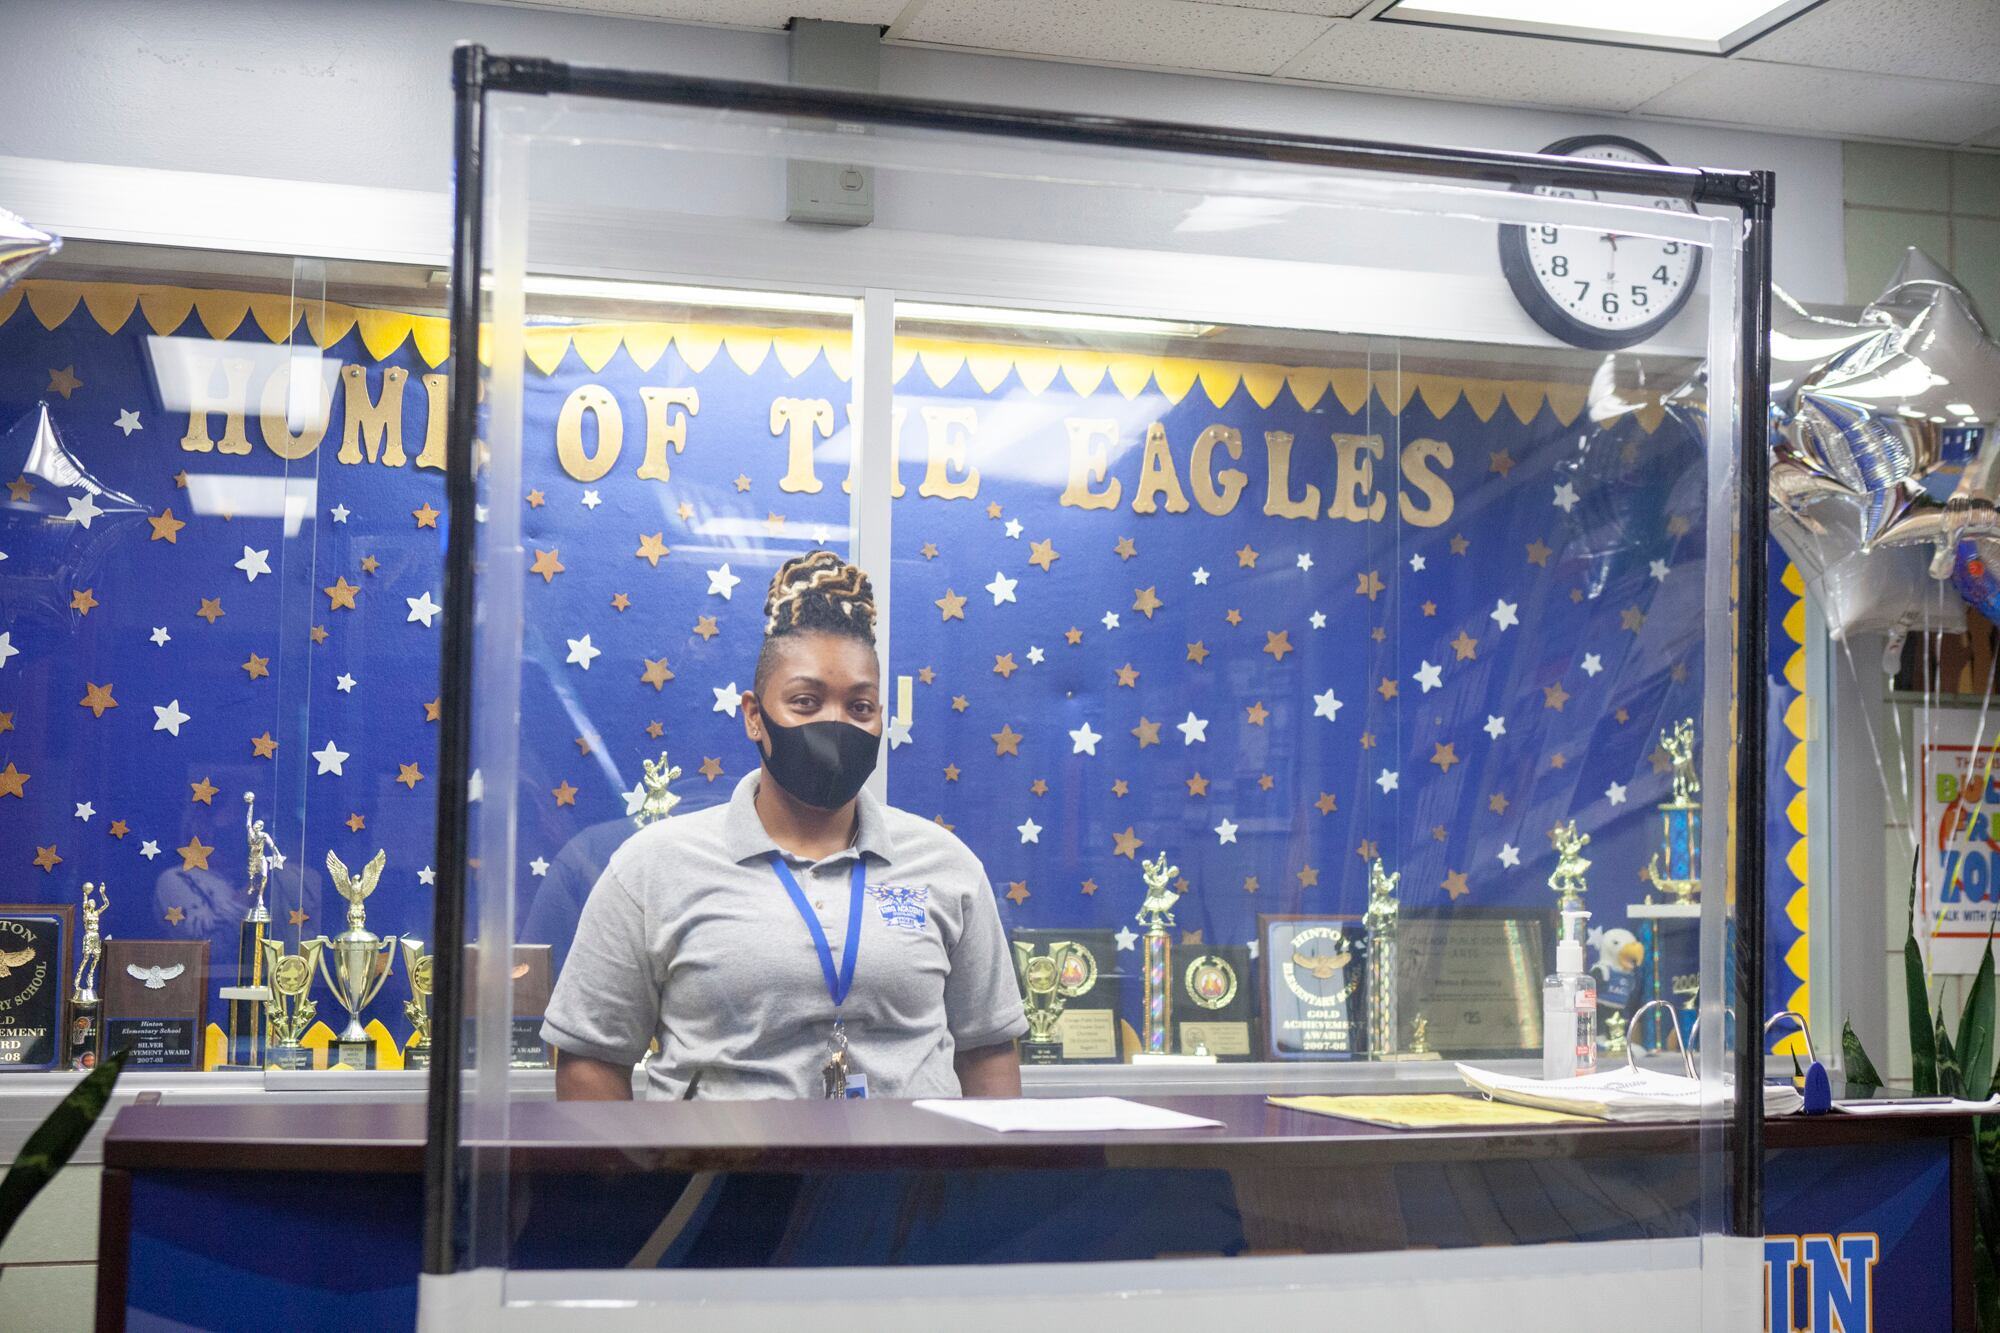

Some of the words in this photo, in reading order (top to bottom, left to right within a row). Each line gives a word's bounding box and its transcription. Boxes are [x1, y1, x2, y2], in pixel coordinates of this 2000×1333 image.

[1540, 225, 1558, 245] 9
[1551, 255, 1569, 277] 8
[1652, 265, 1670, 286] 4
[1573, 280, 1590, 302] 7
[1631, 285, 1648, 307] 5
[1602, 292, 1619, 315] 6
[556, 383, 701, 483] OF
[1060, 417, 1455, 527] EAGLES
[1963, 911, 1987, 921] WITH
[14, 961, 47, 1006] SCHOOL
[1306, 1009, 1341, 1019] GOLD
[0, 1040, 21, 1049] RD
[1303, 1031, 1346, 1041] AWARD
